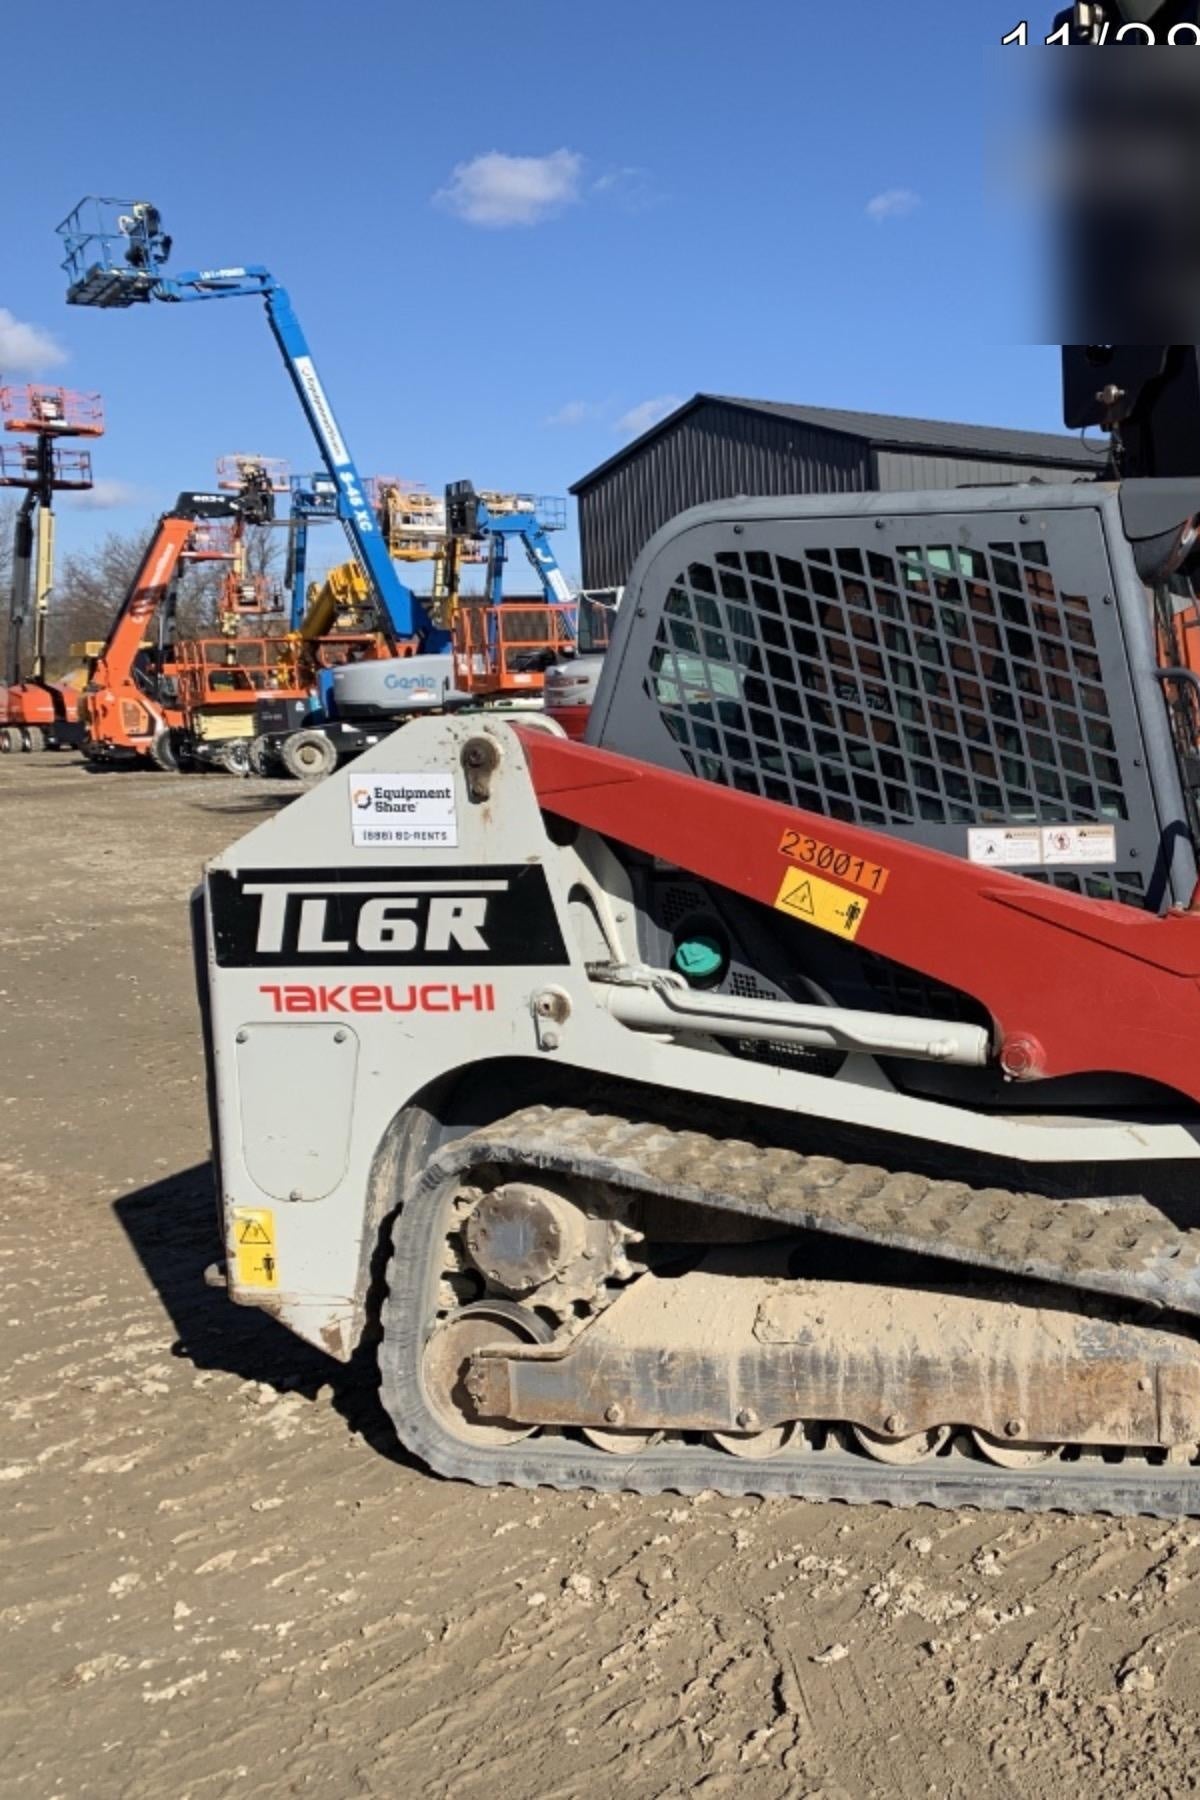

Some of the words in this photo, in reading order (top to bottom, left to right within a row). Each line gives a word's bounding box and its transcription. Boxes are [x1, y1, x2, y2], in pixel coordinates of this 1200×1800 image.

[373, 786, 452, 802] Equipment
[375, 801, 417, 813] Share
[781, 831, 883, 890] 230011
[241, 879, 509, 953] TL6R
[259, 983, 496, 1013] TAKEUCHI
